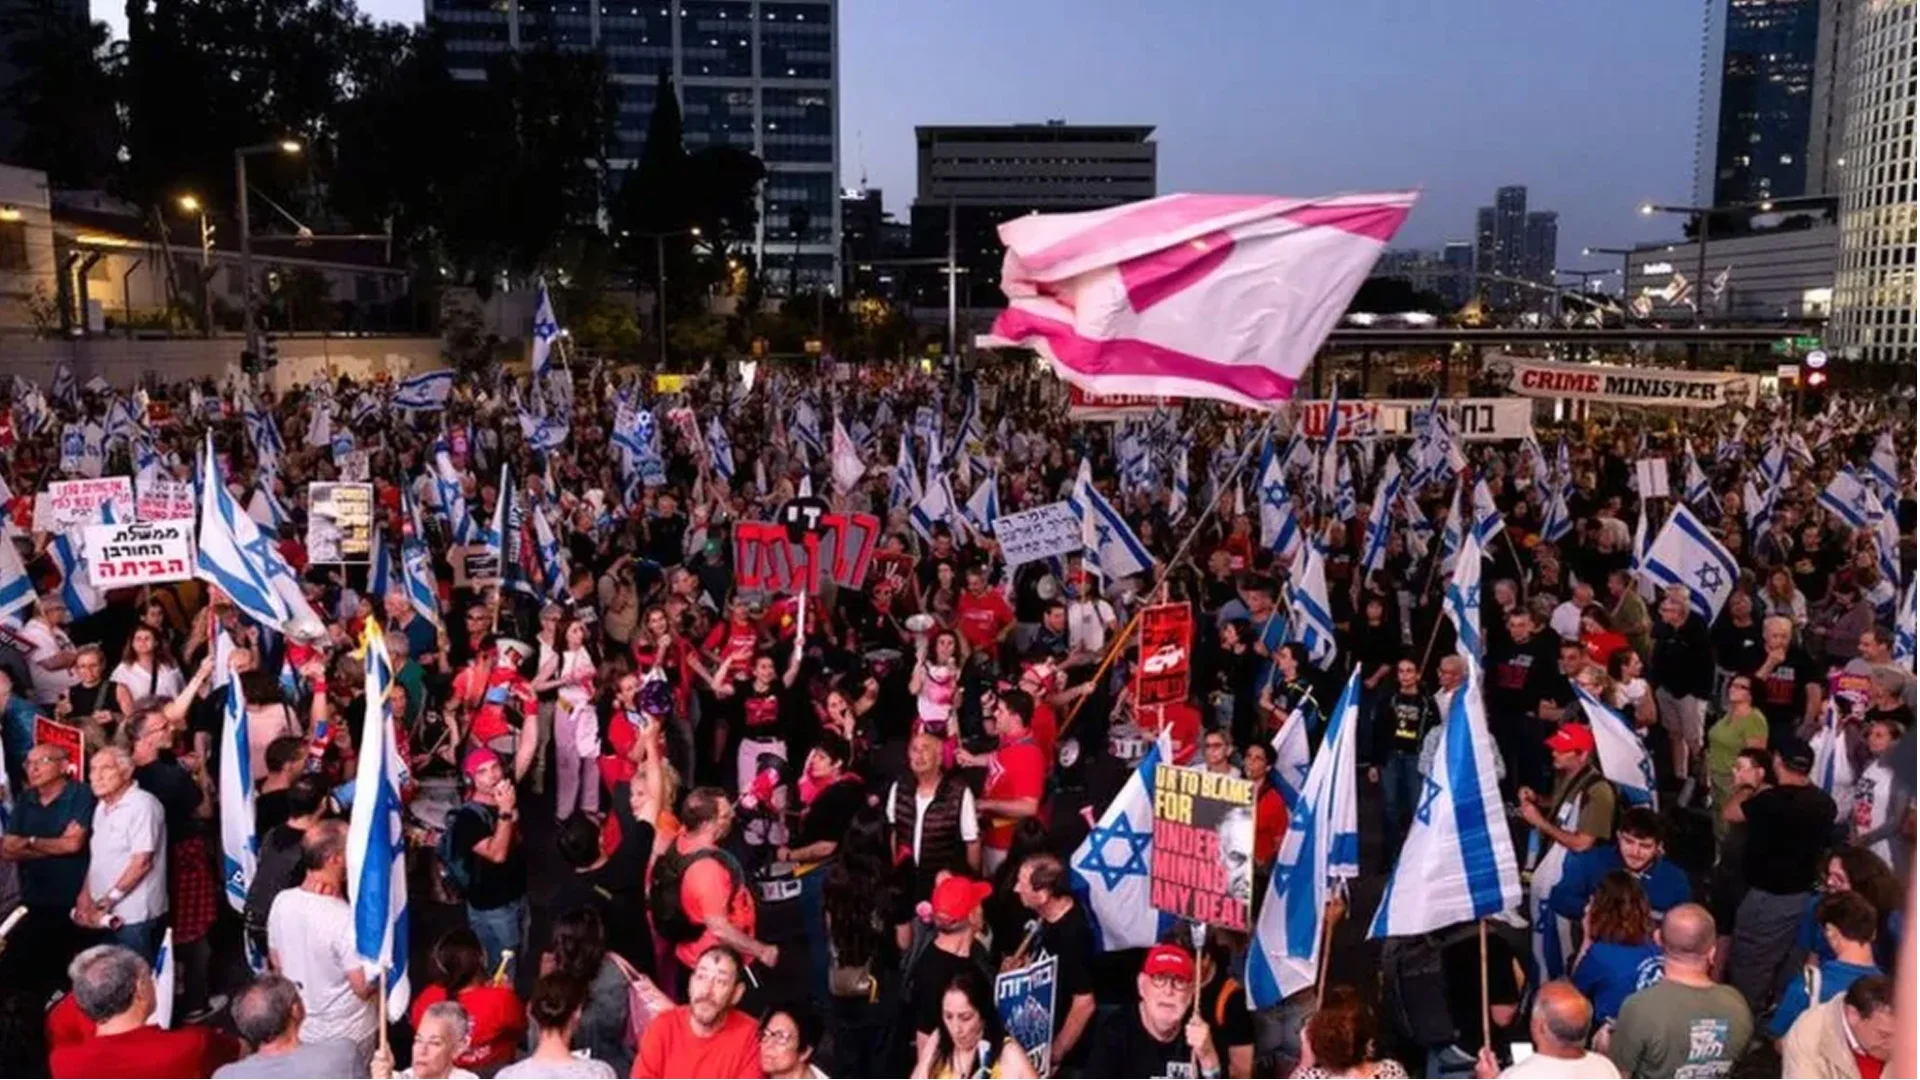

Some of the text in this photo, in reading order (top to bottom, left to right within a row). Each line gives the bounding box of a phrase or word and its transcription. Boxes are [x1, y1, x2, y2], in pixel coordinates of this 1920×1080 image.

[1522, 370, 1716, 400] CRIME MINISTER
[112, 524, 179, 542] ממשלת
[98, 559, 184, 578] הביתה
[102, 544, 164, 561] החורבן
[1180, 770, 1199, 796] TO
[1201, 774, 1253, 804] BLAME
[1155, 789, 1193, 825] FOR
[1154, 820, 1221, 861] UNDER
[1153, 850, 1229, 893] MINING
[1152, 878, 1247, 929] ANY DEAL
